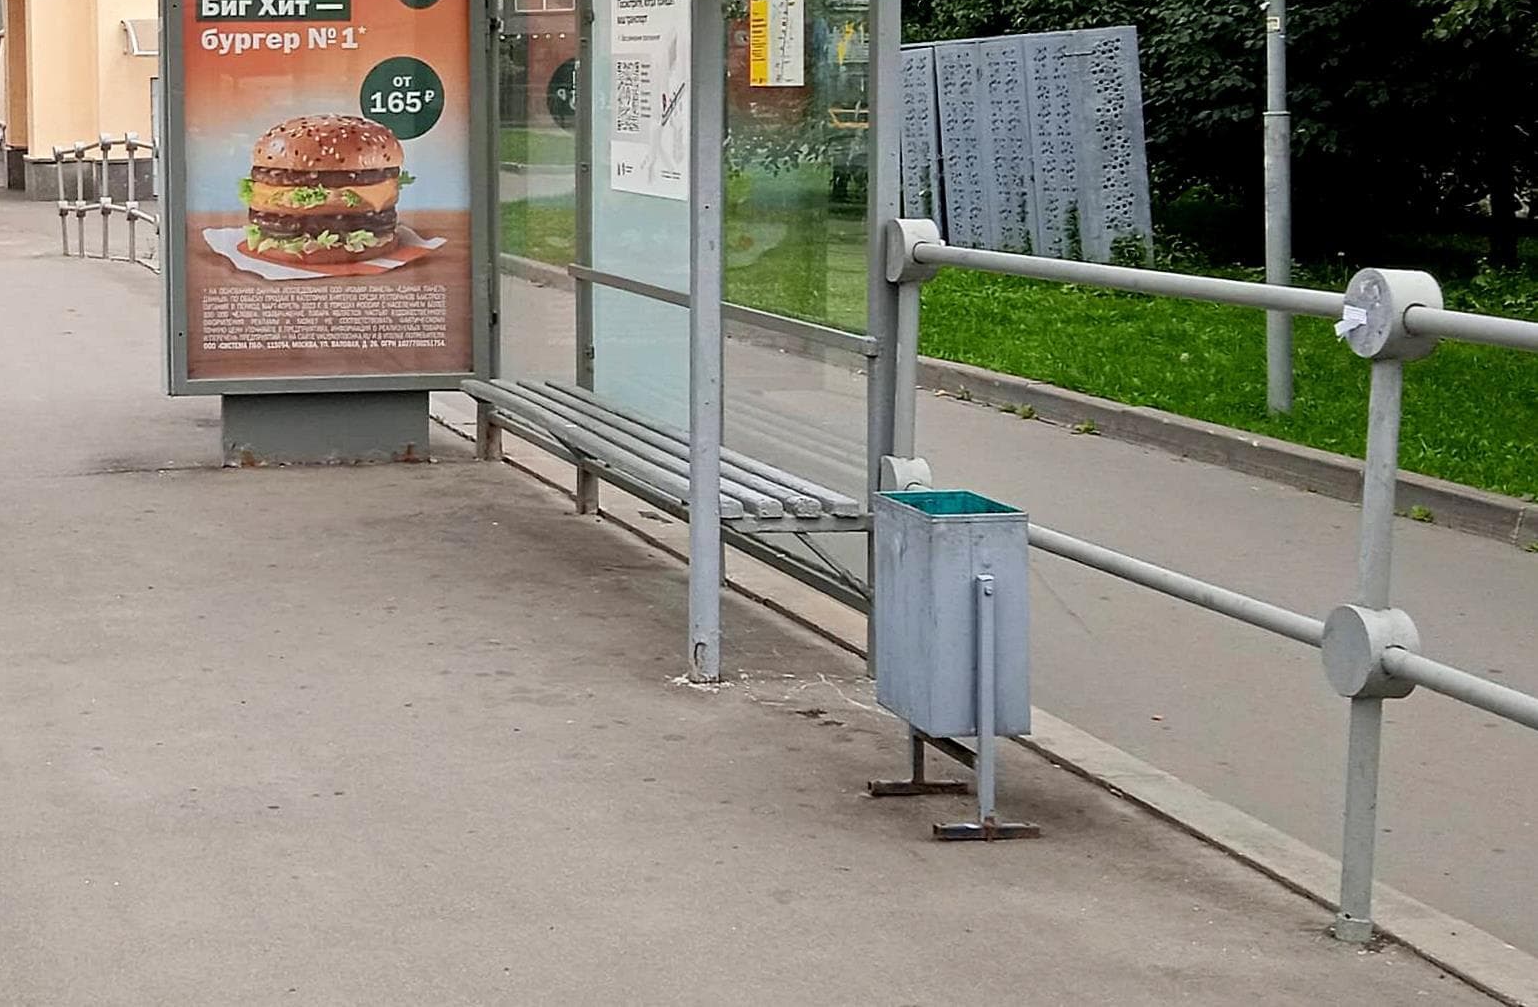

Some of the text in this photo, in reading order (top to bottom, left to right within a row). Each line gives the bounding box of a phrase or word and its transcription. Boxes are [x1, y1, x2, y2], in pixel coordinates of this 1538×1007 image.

[201, 27, 301, 55] бургер
[308, 27, 337, 49] №
[392, 76, 413, 88] от
